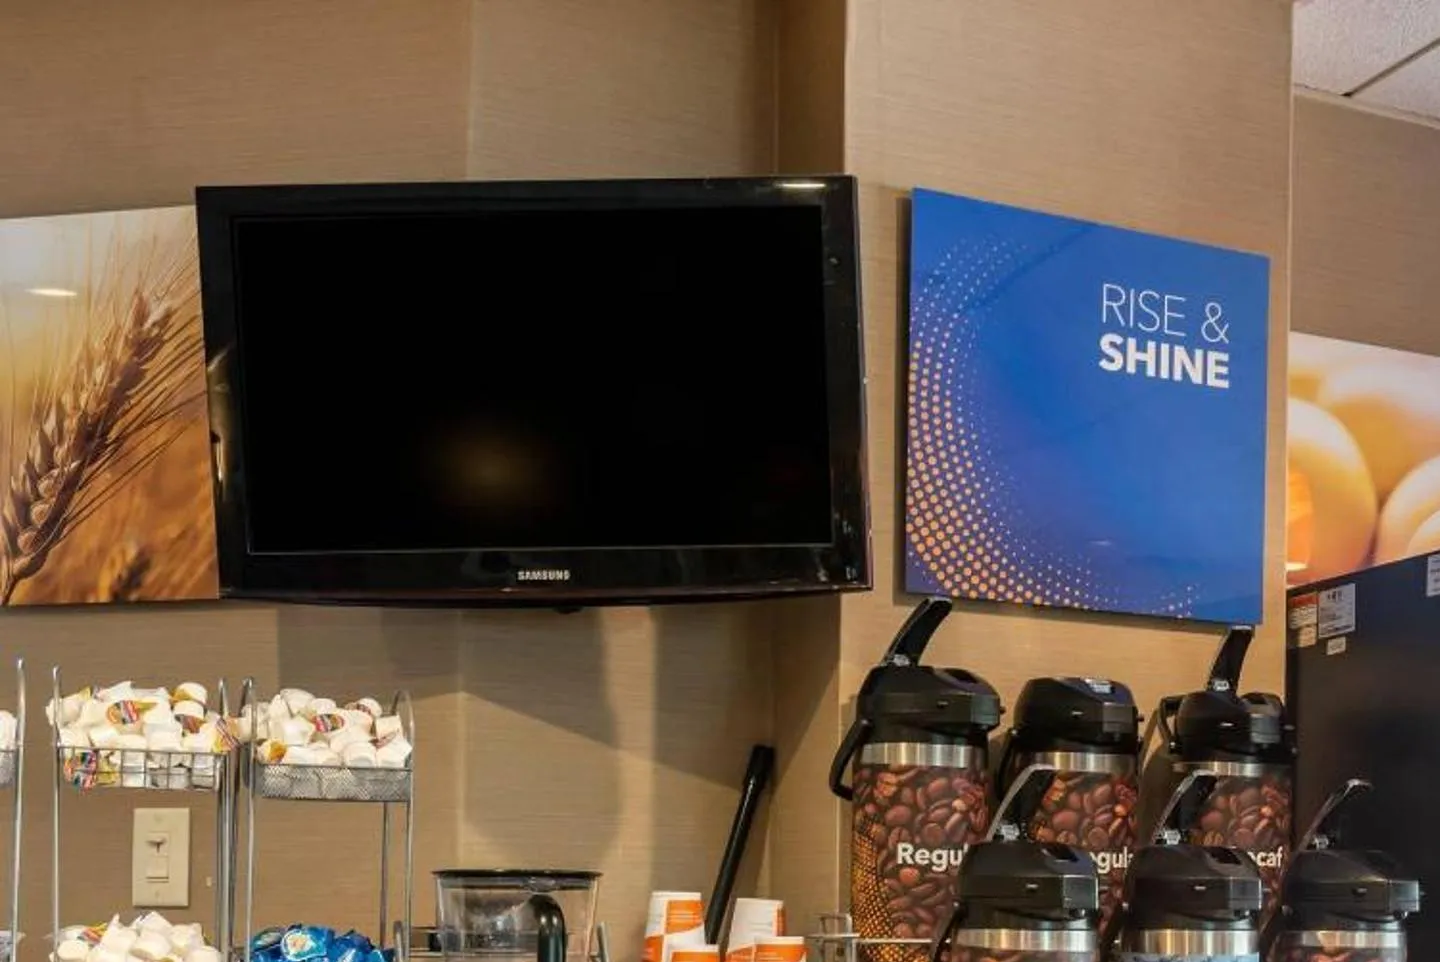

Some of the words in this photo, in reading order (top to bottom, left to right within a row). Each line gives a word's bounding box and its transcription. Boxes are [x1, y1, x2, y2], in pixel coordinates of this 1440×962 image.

[1102, 283, 1186, 337] RISE
[1201, 302, 1230, 344] &
[1099, 333, 1230, 389] SHINE
[517, 569, 571, 581] SAMSUNG
